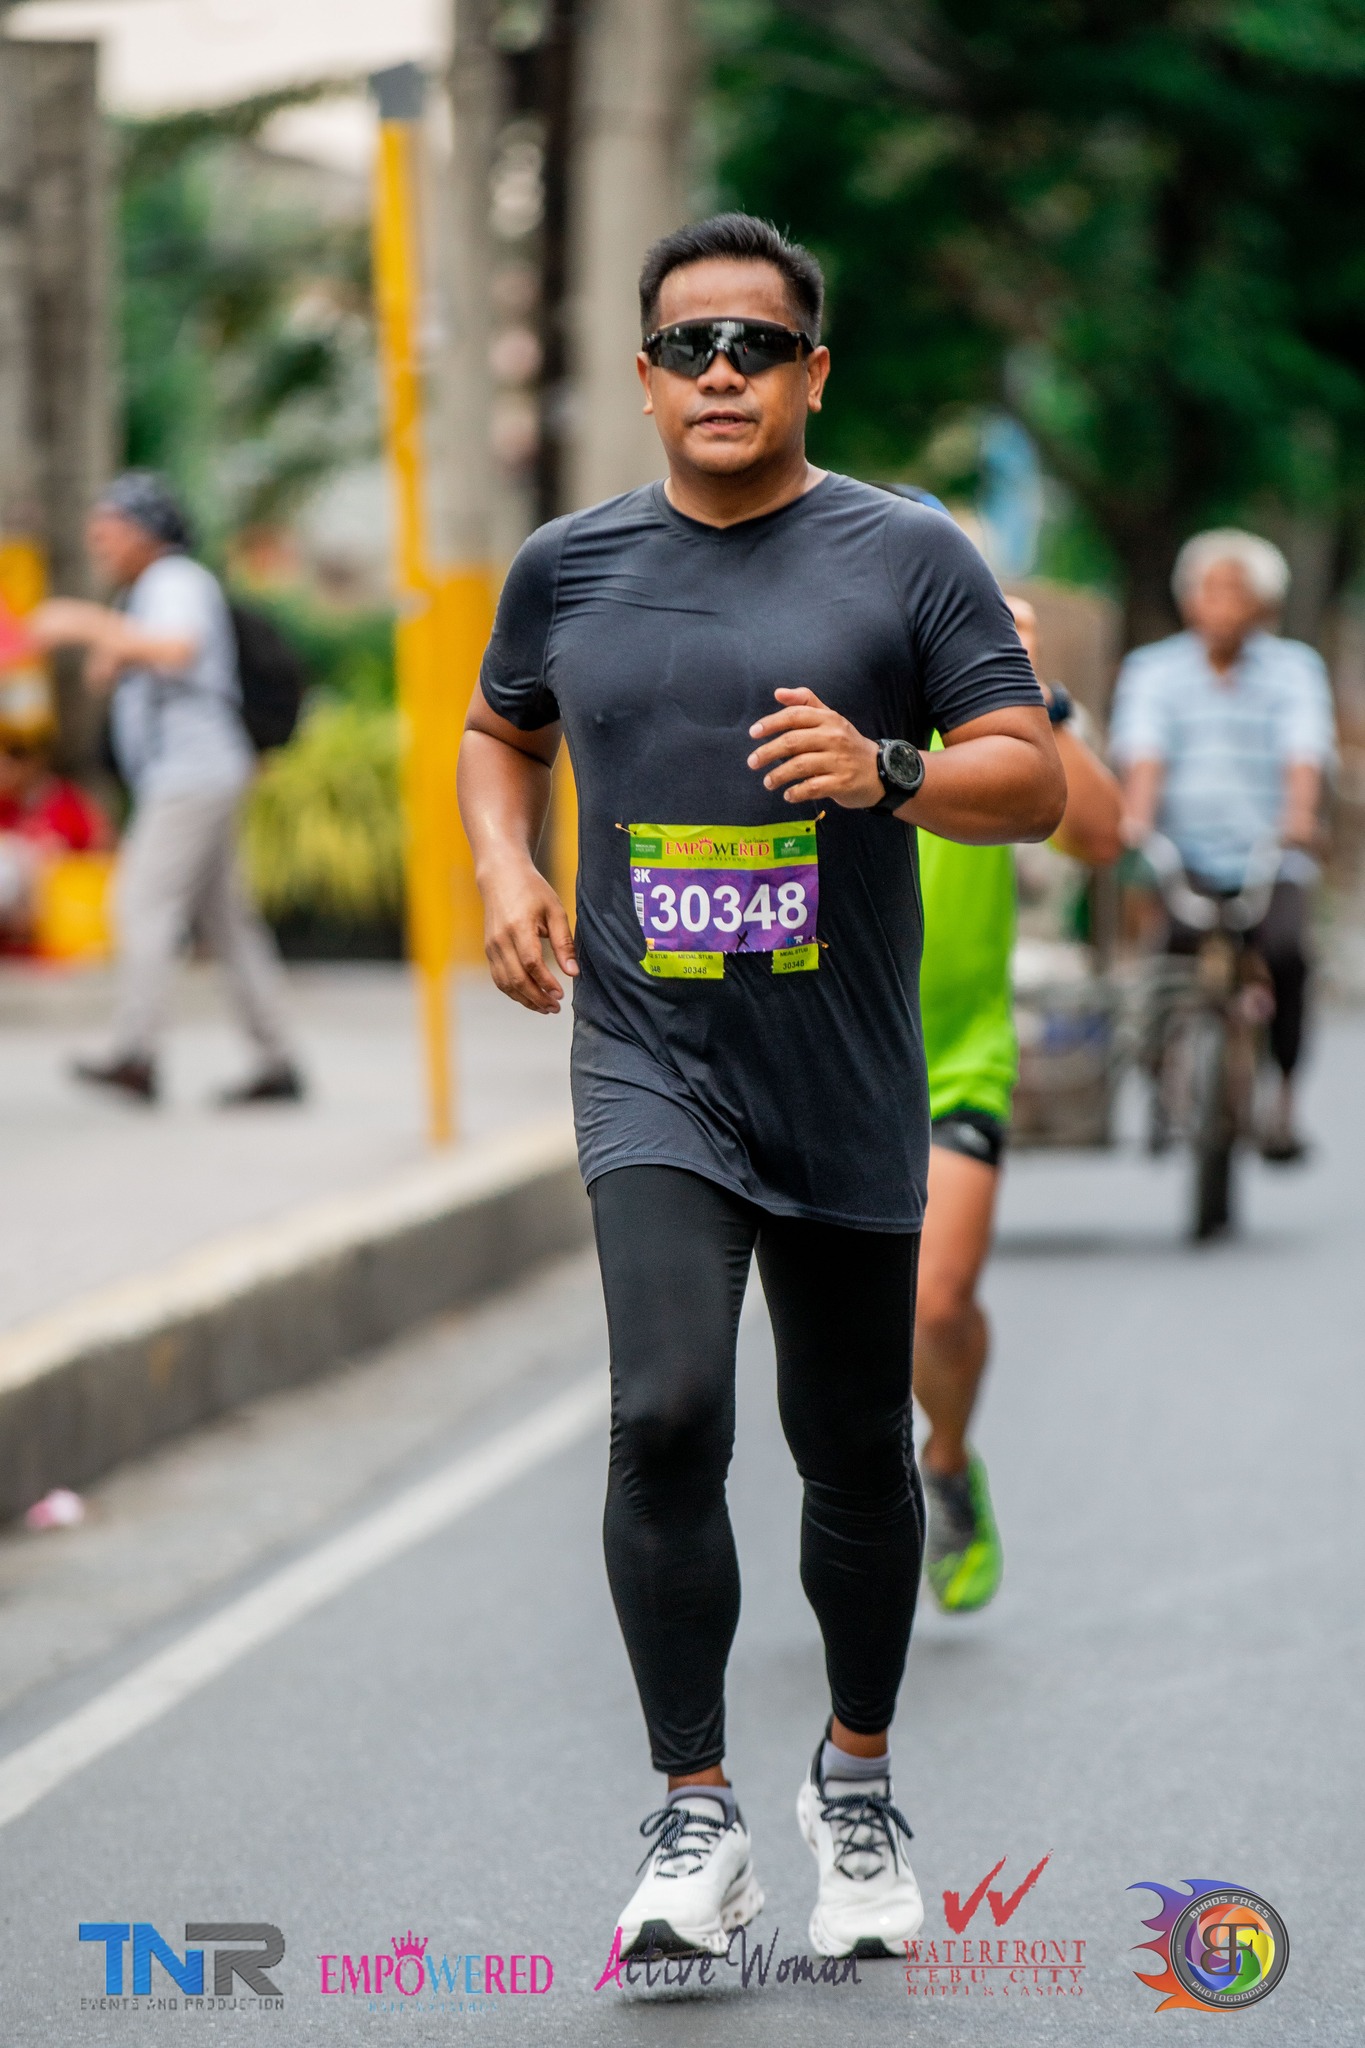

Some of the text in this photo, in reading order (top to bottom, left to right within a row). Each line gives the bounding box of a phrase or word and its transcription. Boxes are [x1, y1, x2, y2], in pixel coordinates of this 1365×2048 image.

[666, 841, 769, 857] EMPOWERED
[634, 868, 651, 883] 3K
[650, 882, 808, 932] 30348
[794, 947, 808, 955] STUB
[683, 966, 707, 974] 30348
[782, 959, 805, 971] 30348
